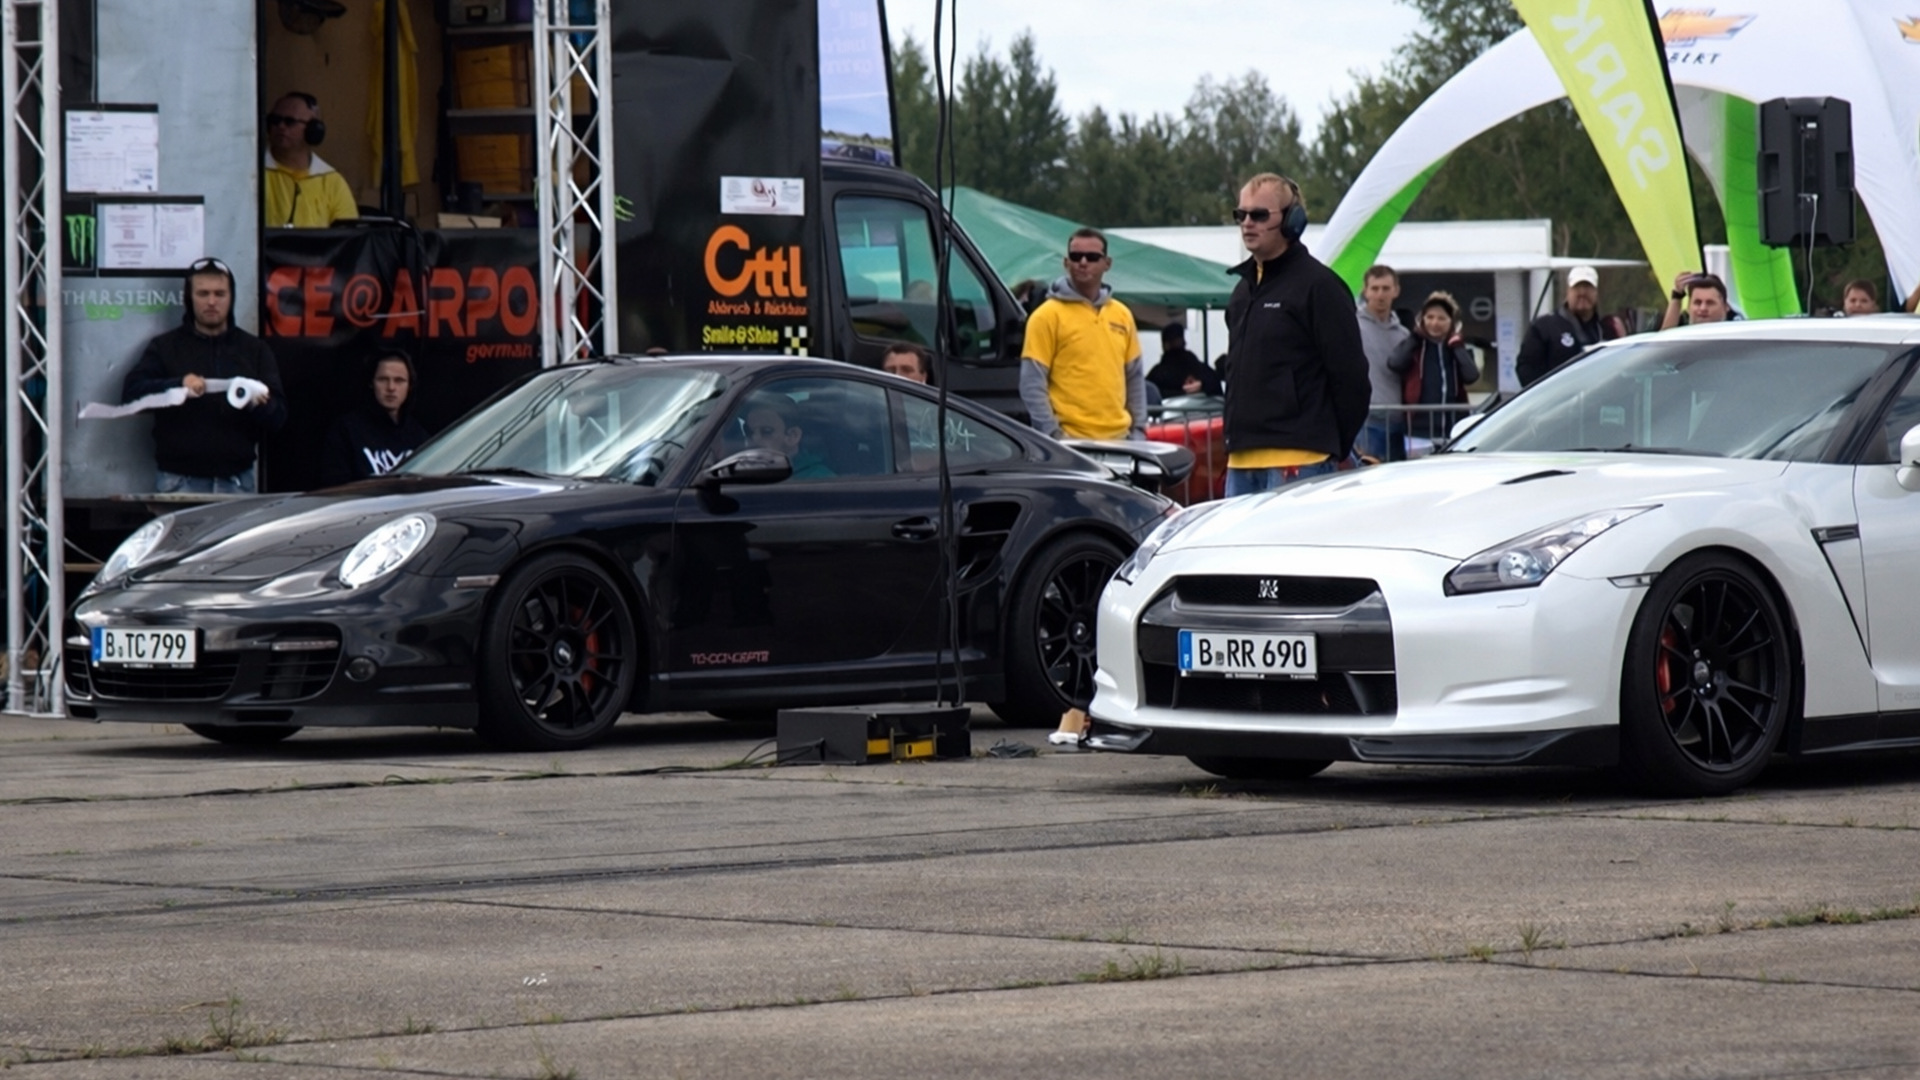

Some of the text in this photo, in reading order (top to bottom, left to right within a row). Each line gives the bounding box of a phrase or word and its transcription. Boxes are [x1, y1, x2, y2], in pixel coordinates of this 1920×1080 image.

[105, 632, 115, 657] B
[1199, 638, 1307, 668] B RR 690
